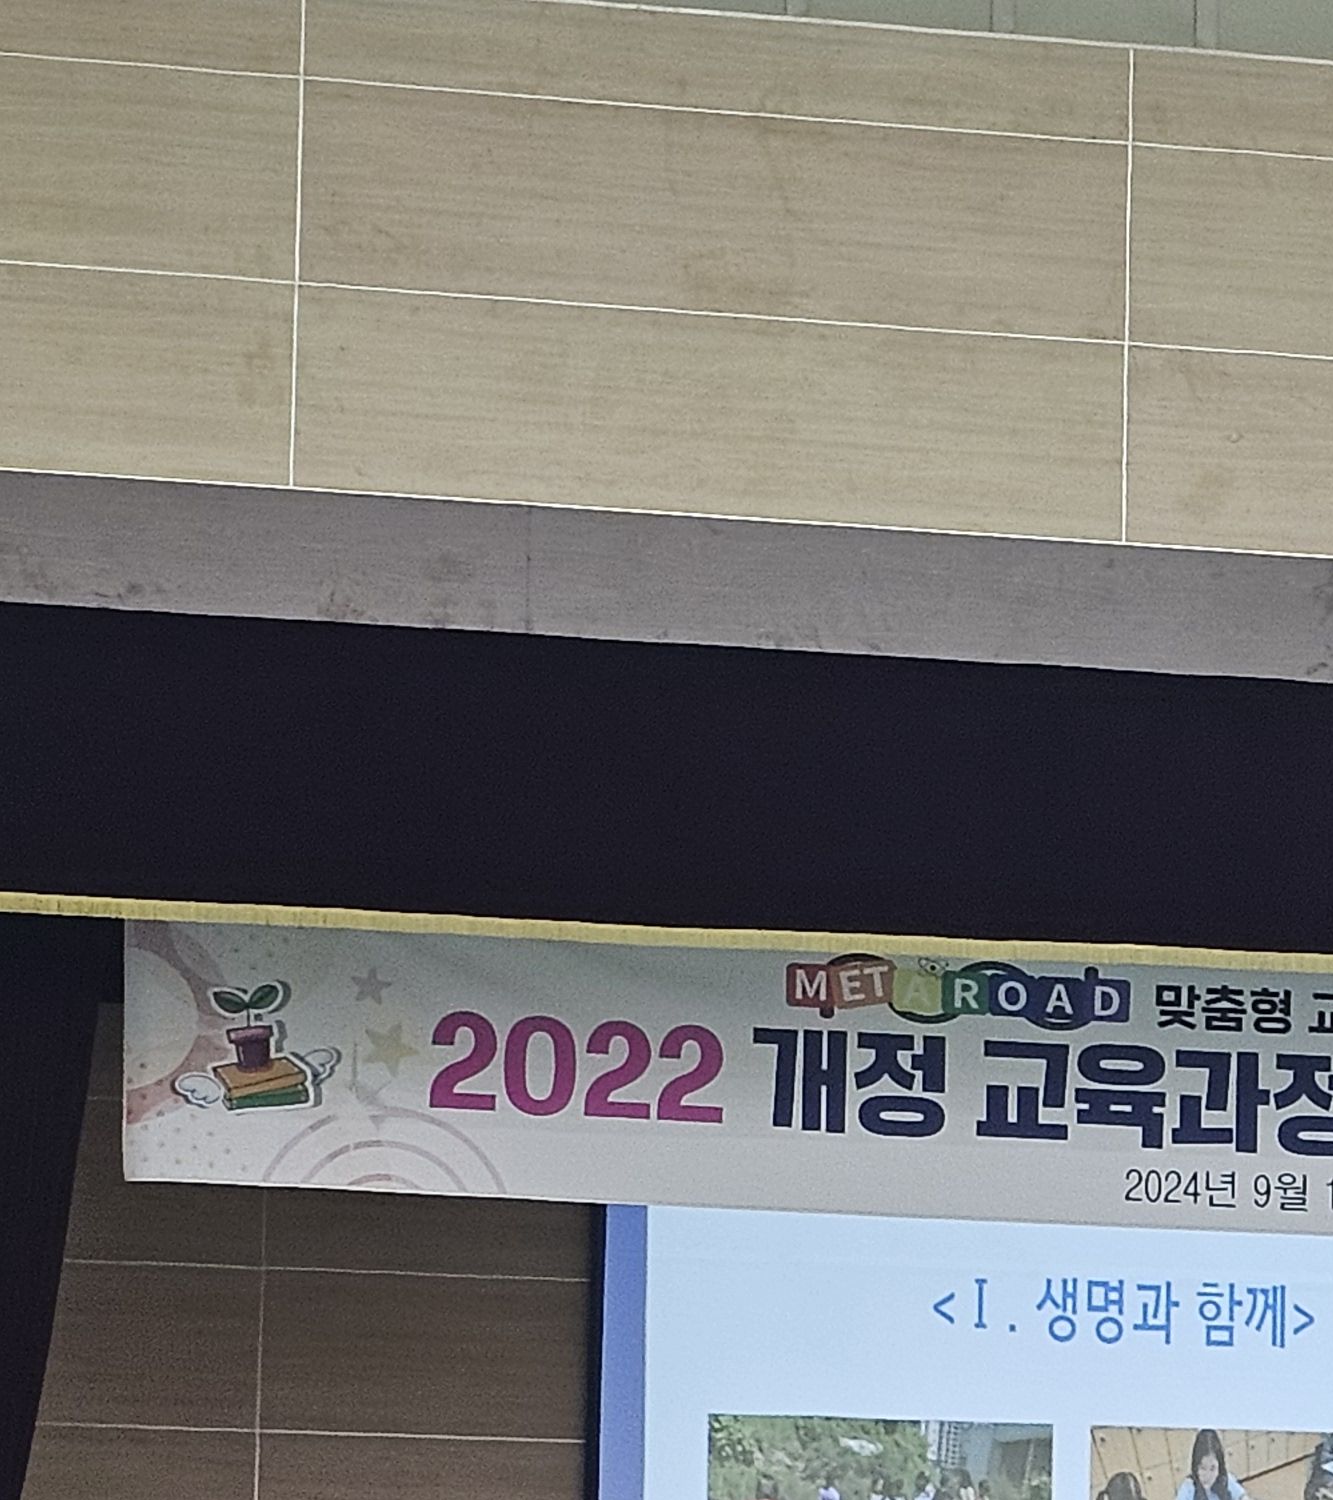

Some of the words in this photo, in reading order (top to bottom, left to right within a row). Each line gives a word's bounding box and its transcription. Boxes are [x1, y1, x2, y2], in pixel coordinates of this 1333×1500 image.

[1155, 984, 1292, 1035] 맞춤형
[428, 1008, 726, 1126] 2022
[752, 1021, 947, 1138] 개정
[1124, 1168, 1237, 1209] 2024년
[1253, 1172, 1308, 1213] 9월
[1035, 1277, 1180, 1345] 생명과
[1196, 1282, 1315, 1349] 함께>
